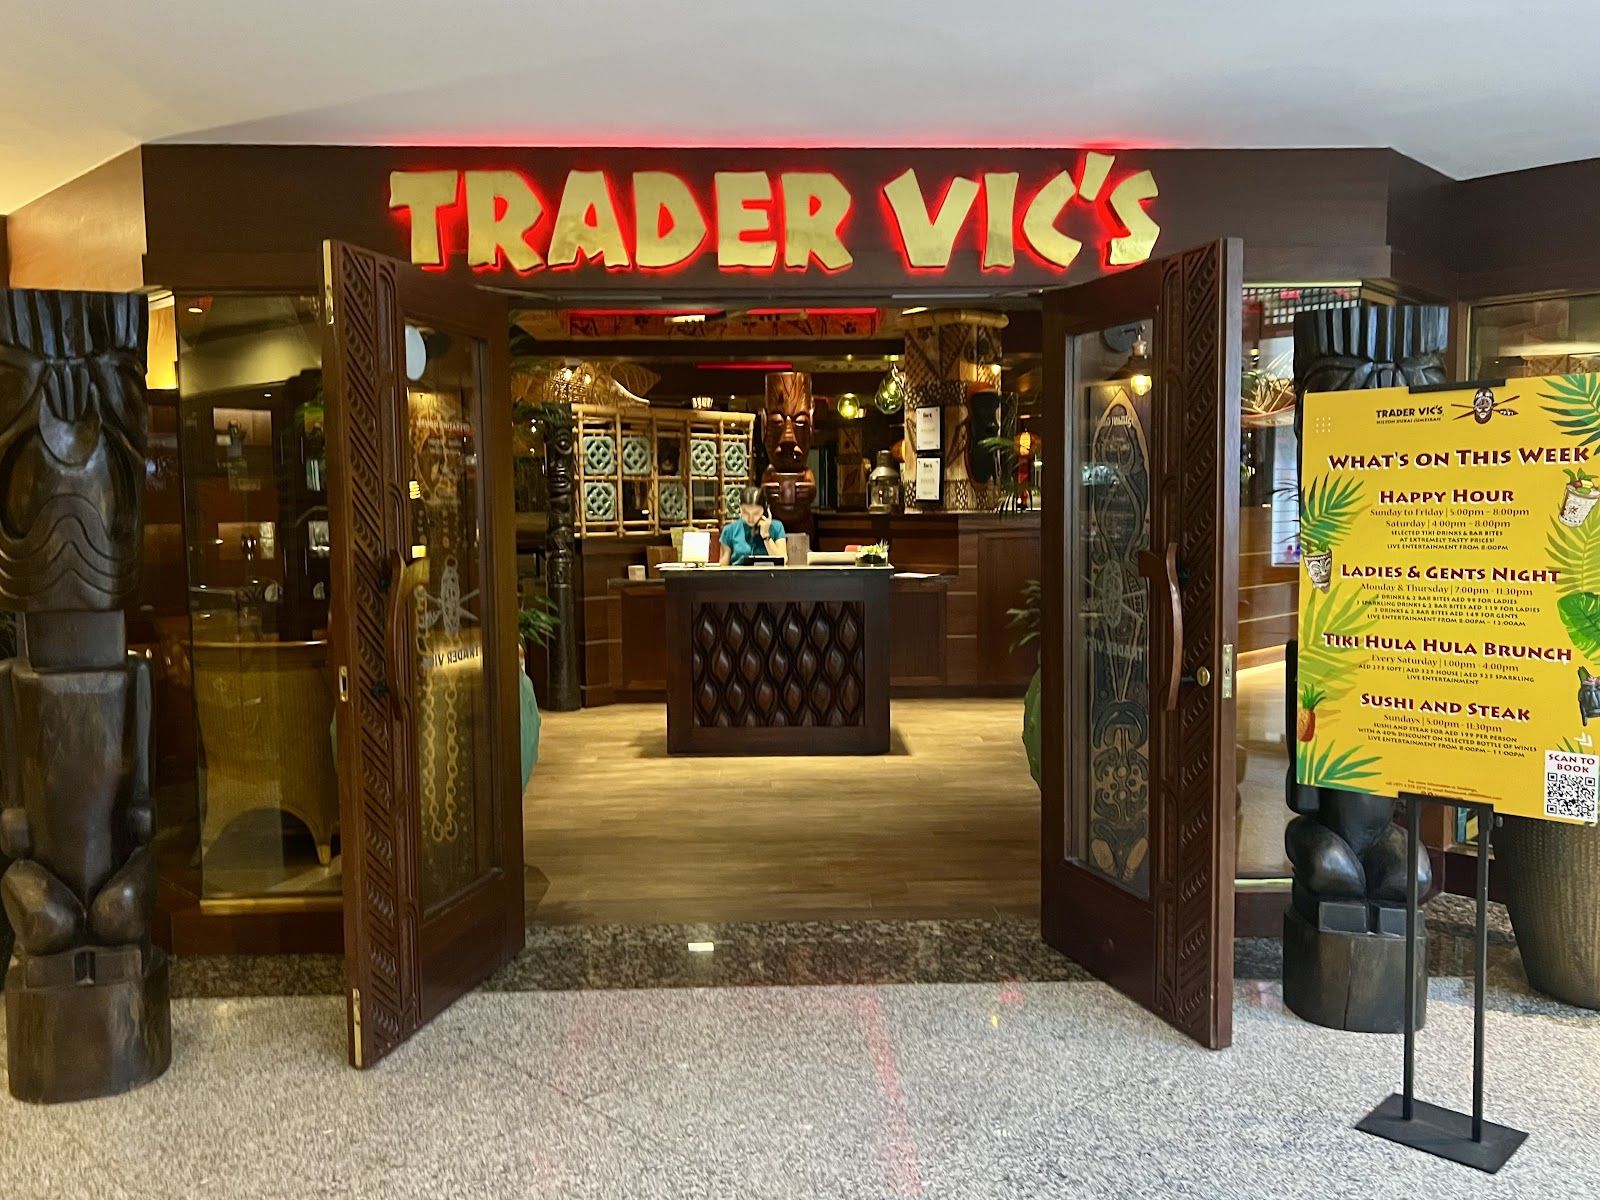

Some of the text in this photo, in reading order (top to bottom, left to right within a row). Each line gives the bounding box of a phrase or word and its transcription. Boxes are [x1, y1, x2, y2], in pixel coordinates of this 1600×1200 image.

[390, 153, 1161, 273] TRADER VIC'S
[1376, 405, 1443, 418] TRADER VIC'S
[1328, 447, 1589, 469] WHAT'S ON THIS WEEK
[1380, 489, 1514, 504] HAPPY HOUR
[1370, 508, 1402, 518] Sunday
[1416, 508, 1444, 518] Friday
[1386, 520, 1425, 529] Saturday
[1342, 564, 1560, 584] LADIES & GENTS NIGHT
[1362, 583, 1394, 592] Monday
[1407, 584, 1448, 594] Thursday
[1323, 632, 1572, 662] TIKI HULA HULA BRUNCH
[1372, 654, 1396, 664] Every
[1397, 656, 1437, 667] Saturday
[1422, 676, 1479, 684] ENTERTAINMENT
[1360, 693, 1530, 722] SUSHI AND STEAK
[1384, 714, 1420, 725] Sundays
[1382, 737, 1436, 747] ENTERTAINMENT
[1548, 753, 1595, 765] SCAN TO
[1557, 763, 1590, 774] BOOK
